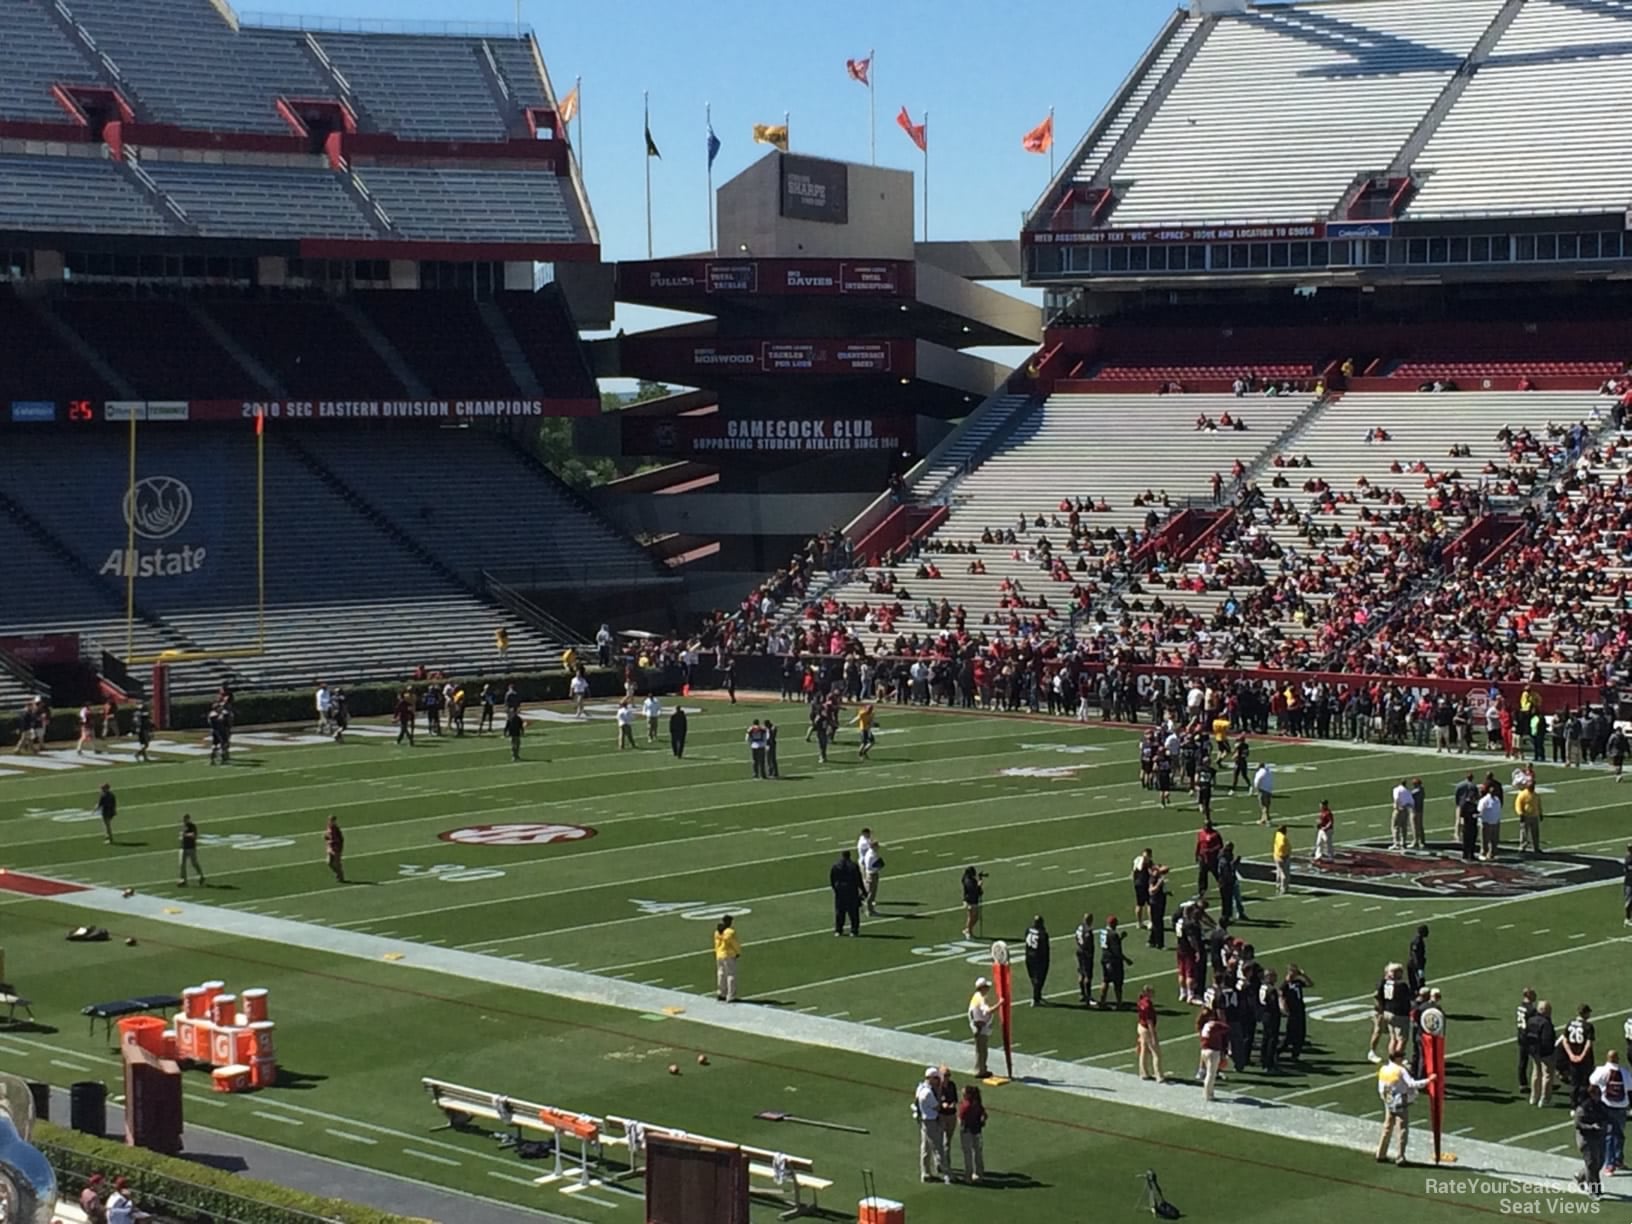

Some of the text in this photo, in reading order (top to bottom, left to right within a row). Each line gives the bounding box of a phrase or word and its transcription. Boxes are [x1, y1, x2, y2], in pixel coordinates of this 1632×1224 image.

[787, 277, 833, 286] DAVIES
[694, 354, 754, 364] NORWOOD
[69, 400, 93, 420] 25
[242, 401, 543, 417] 2010 SEC EASTERN DIVISION CHAMPIONS
[727, 420, 873, 438] GAMECOCK CLUB
[693, 438, 752, 449] SUPPORTING
[757, 438, 802, 450] STUDENT
[806, 438, 850, 450] ATHLETES
[854, 437, 879, 449] SINCE
[1026, 933, 1039, 949] 45
[1568, 1026, 1584, 1044] 26
[215, 1035, 229, 1058] G
